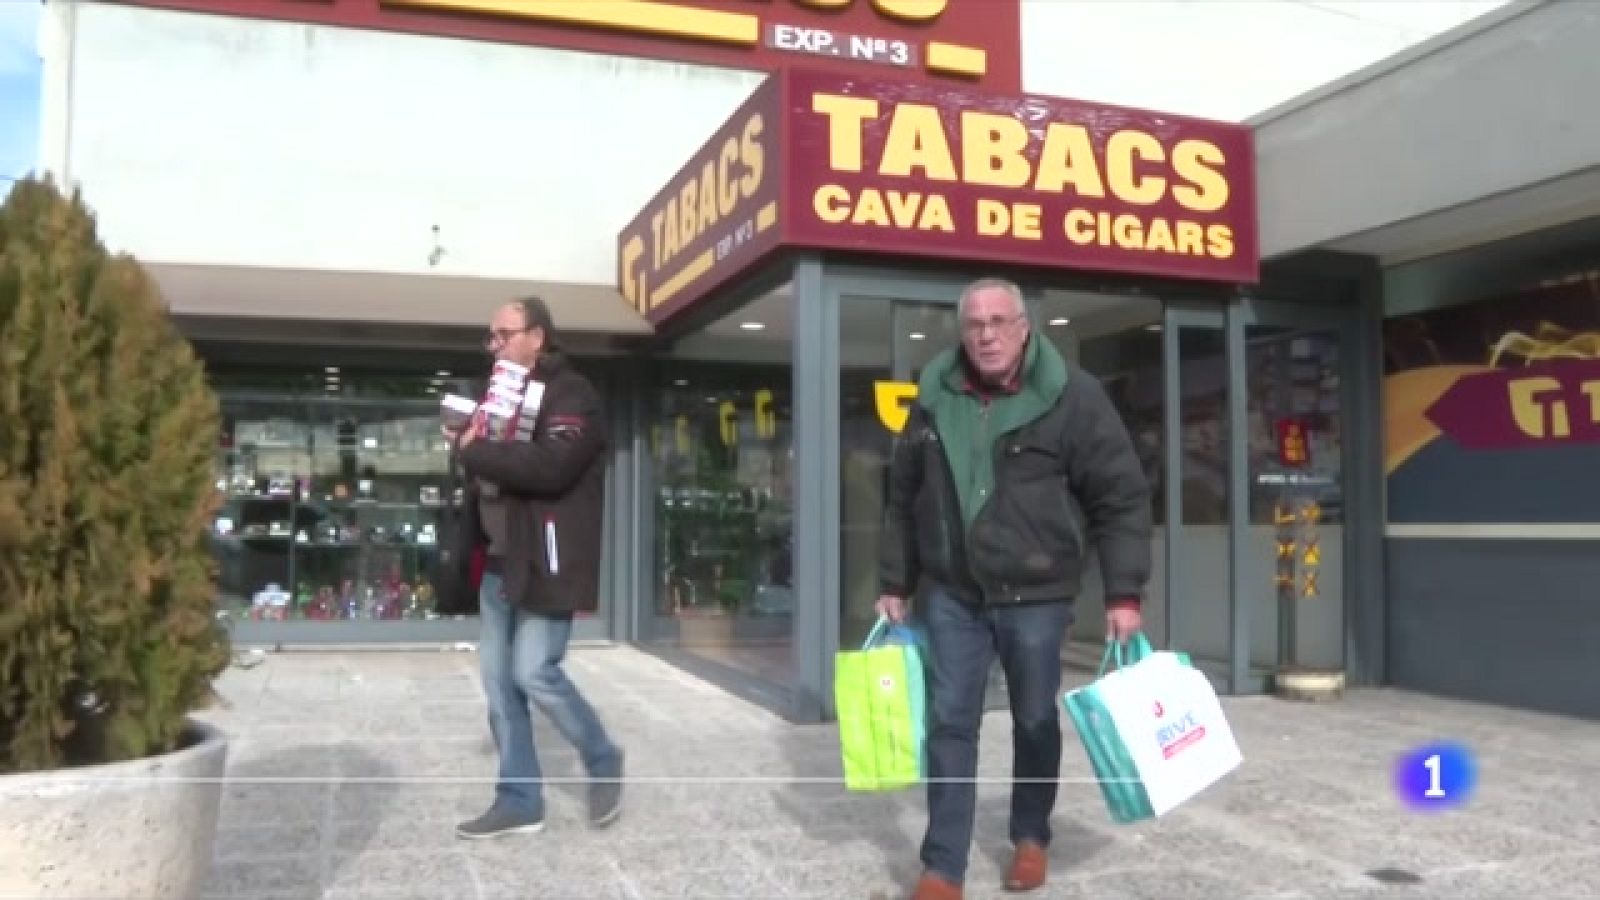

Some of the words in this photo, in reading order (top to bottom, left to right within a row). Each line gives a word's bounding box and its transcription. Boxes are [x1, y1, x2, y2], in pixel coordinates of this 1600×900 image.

[774, 24, 838, 56] EXP.
[652, 112, 765, 271] TABACS
[812, 93, 1230, 212] TABACS
[812, 184, 956, 232] CAVA
[977, 199, 1042, 240] DE
[1064, 209, 1235, 258] CIGARS
